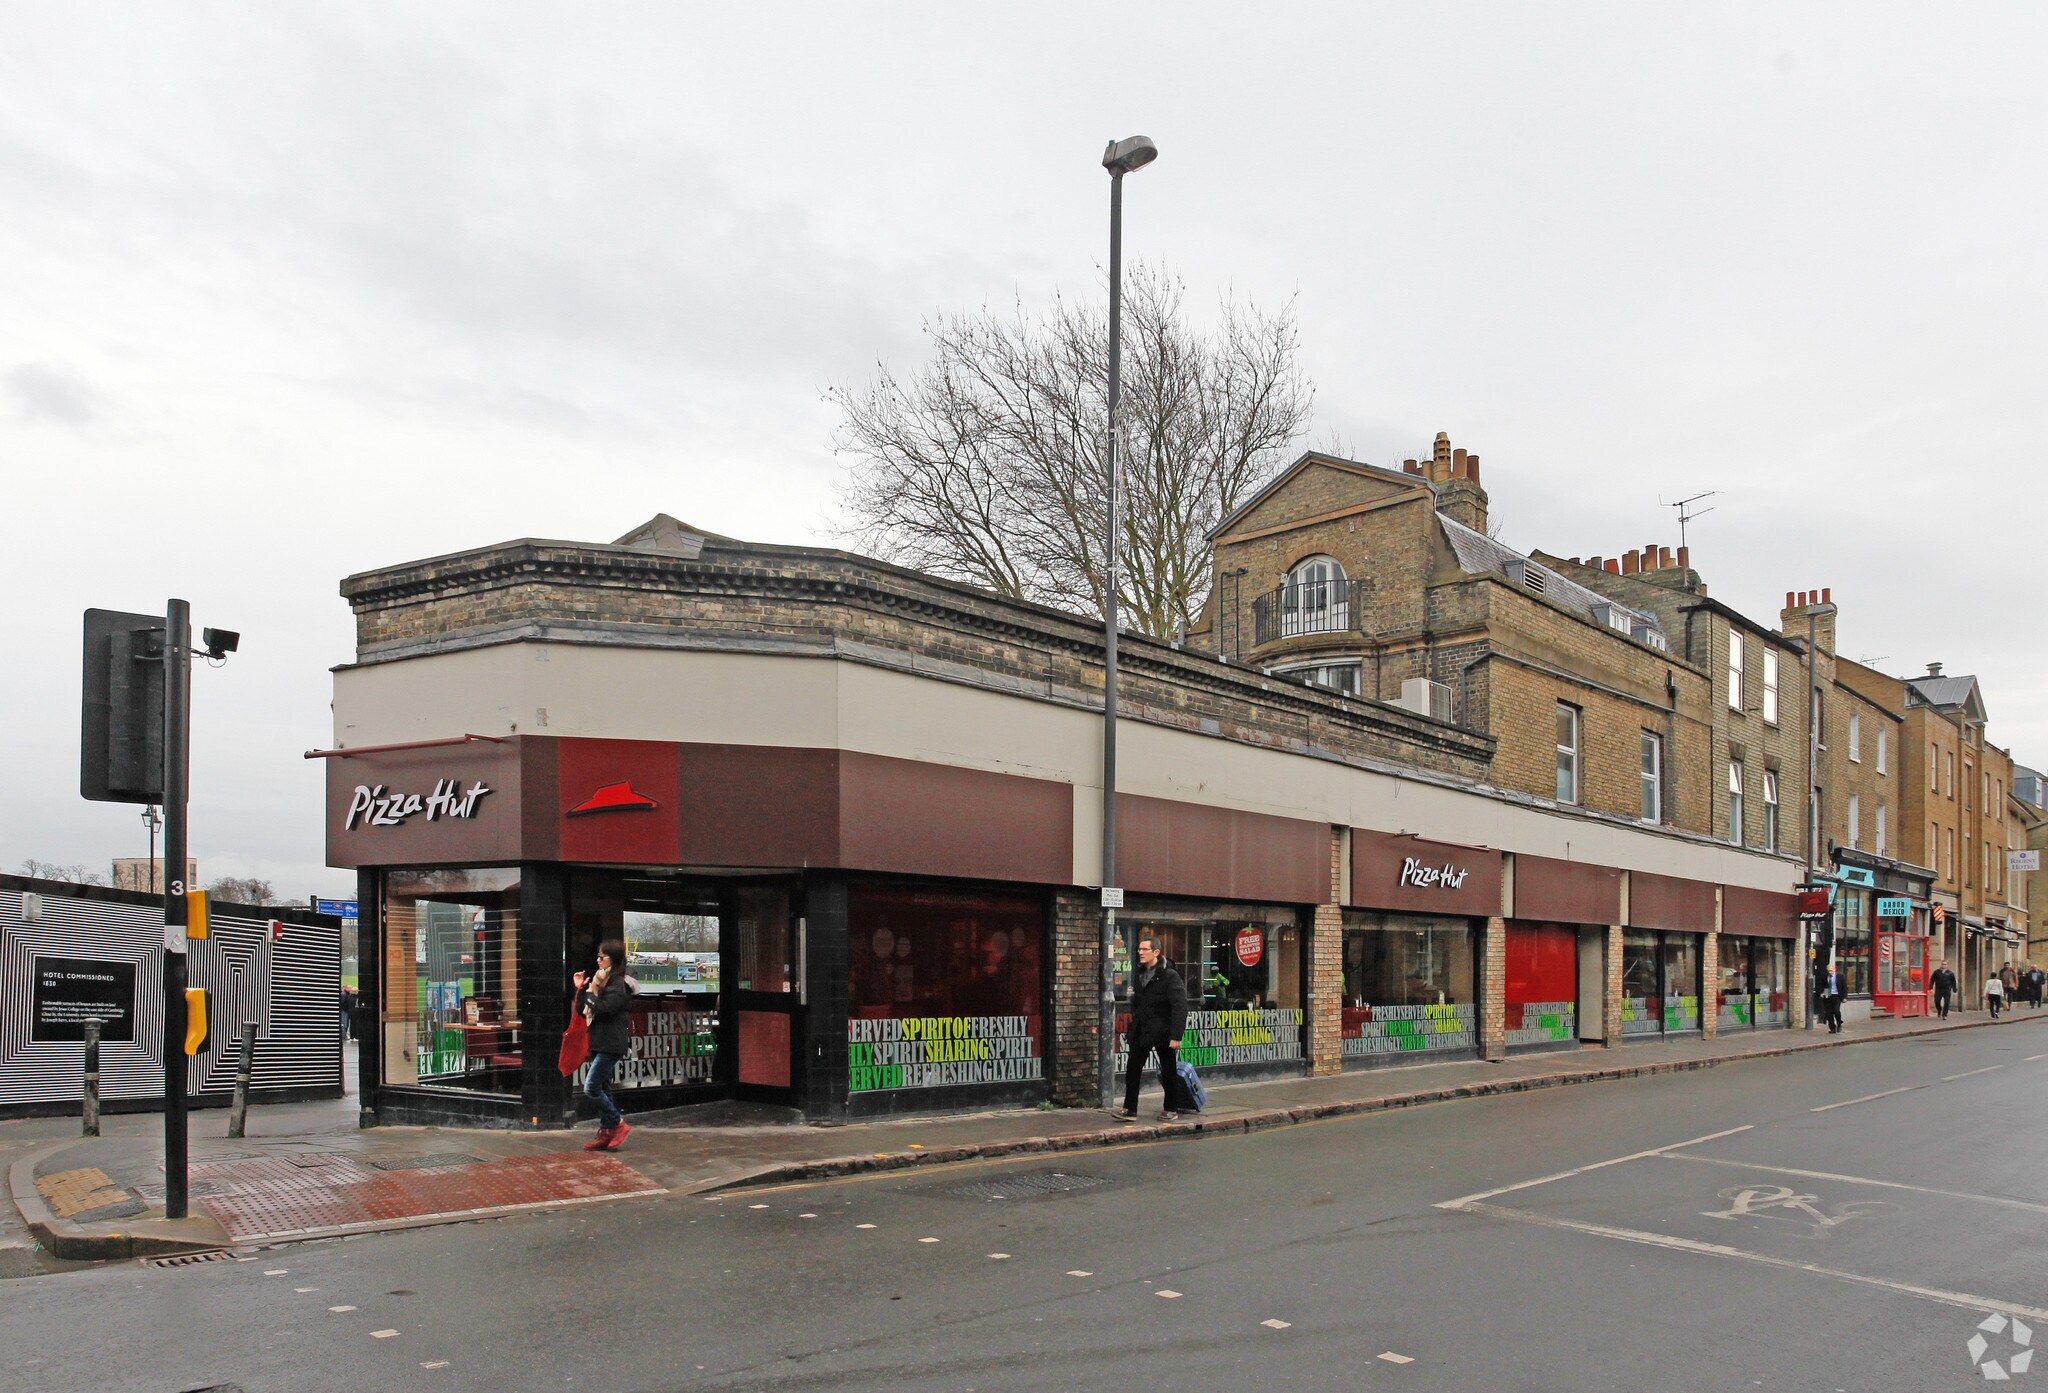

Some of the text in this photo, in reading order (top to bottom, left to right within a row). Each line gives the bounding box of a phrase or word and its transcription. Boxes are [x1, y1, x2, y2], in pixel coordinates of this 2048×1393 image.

[345, 778, 490, 830] Pizza Hut
[1400, 857, 1468, 888] Pizza Hut
[171, 880, 184, 896] 3
[1239, 934, 1260, 945] FREE
[1240, 946, 1260, 955] SALAD
[66, 973, 115, 981] COMMISSIONED
